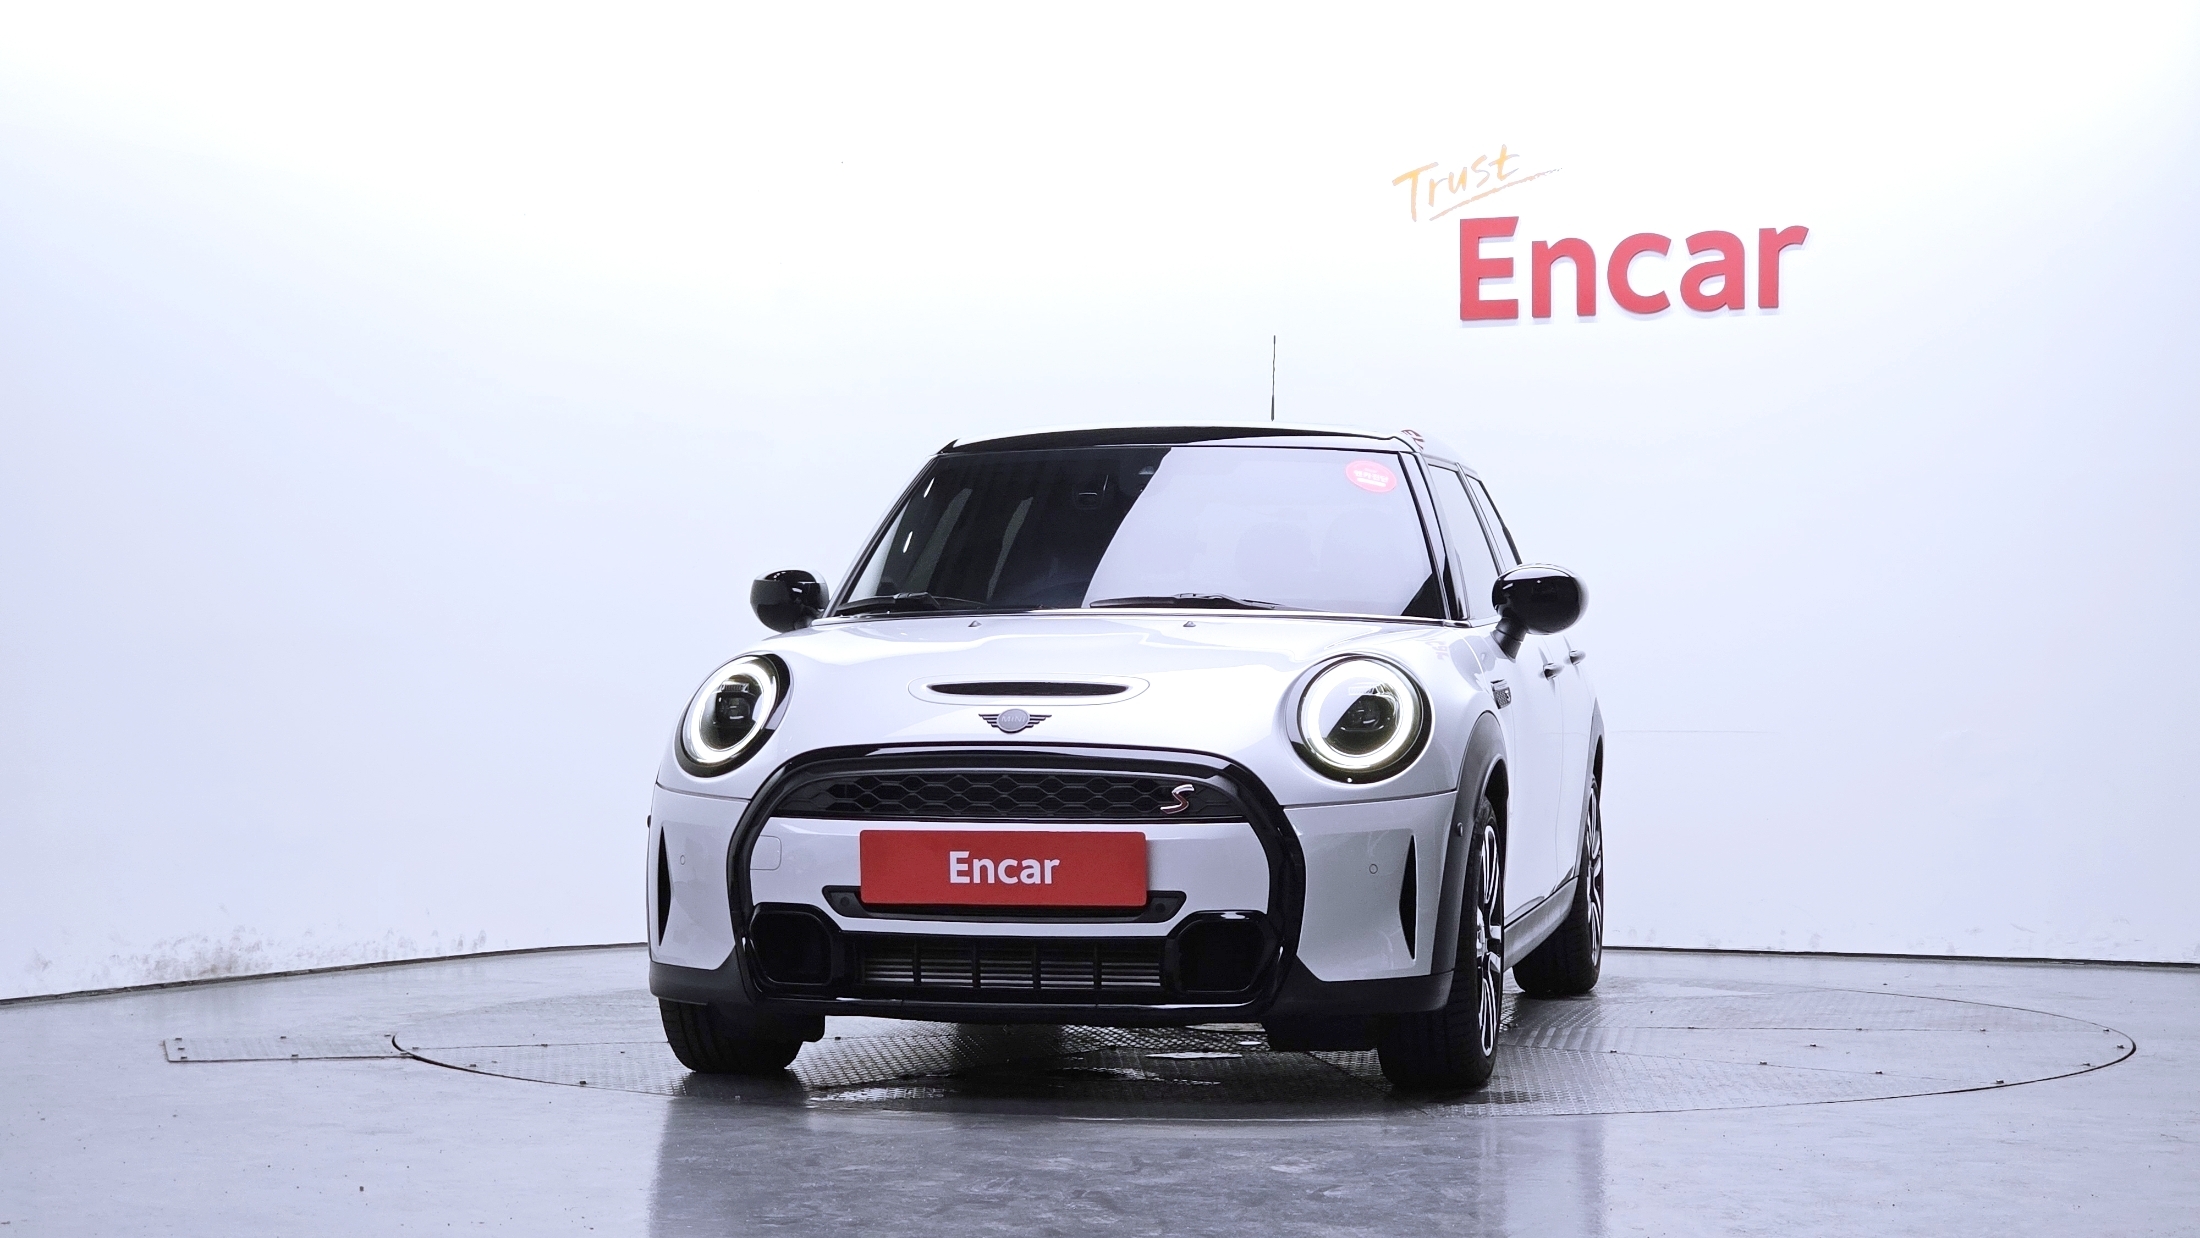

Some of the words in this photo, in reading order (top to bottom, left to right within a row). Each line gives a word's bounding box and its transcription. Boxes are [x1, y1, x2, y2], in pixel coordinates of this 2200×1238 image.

[1392, 144, 1520, 221] Trust
[1460, 216, 1809, 321] Encar
[1001, 715, 1026, 723] MINI
[1160, 784, 1194, 814] S
[949, 851, 1060, 884] Encar
